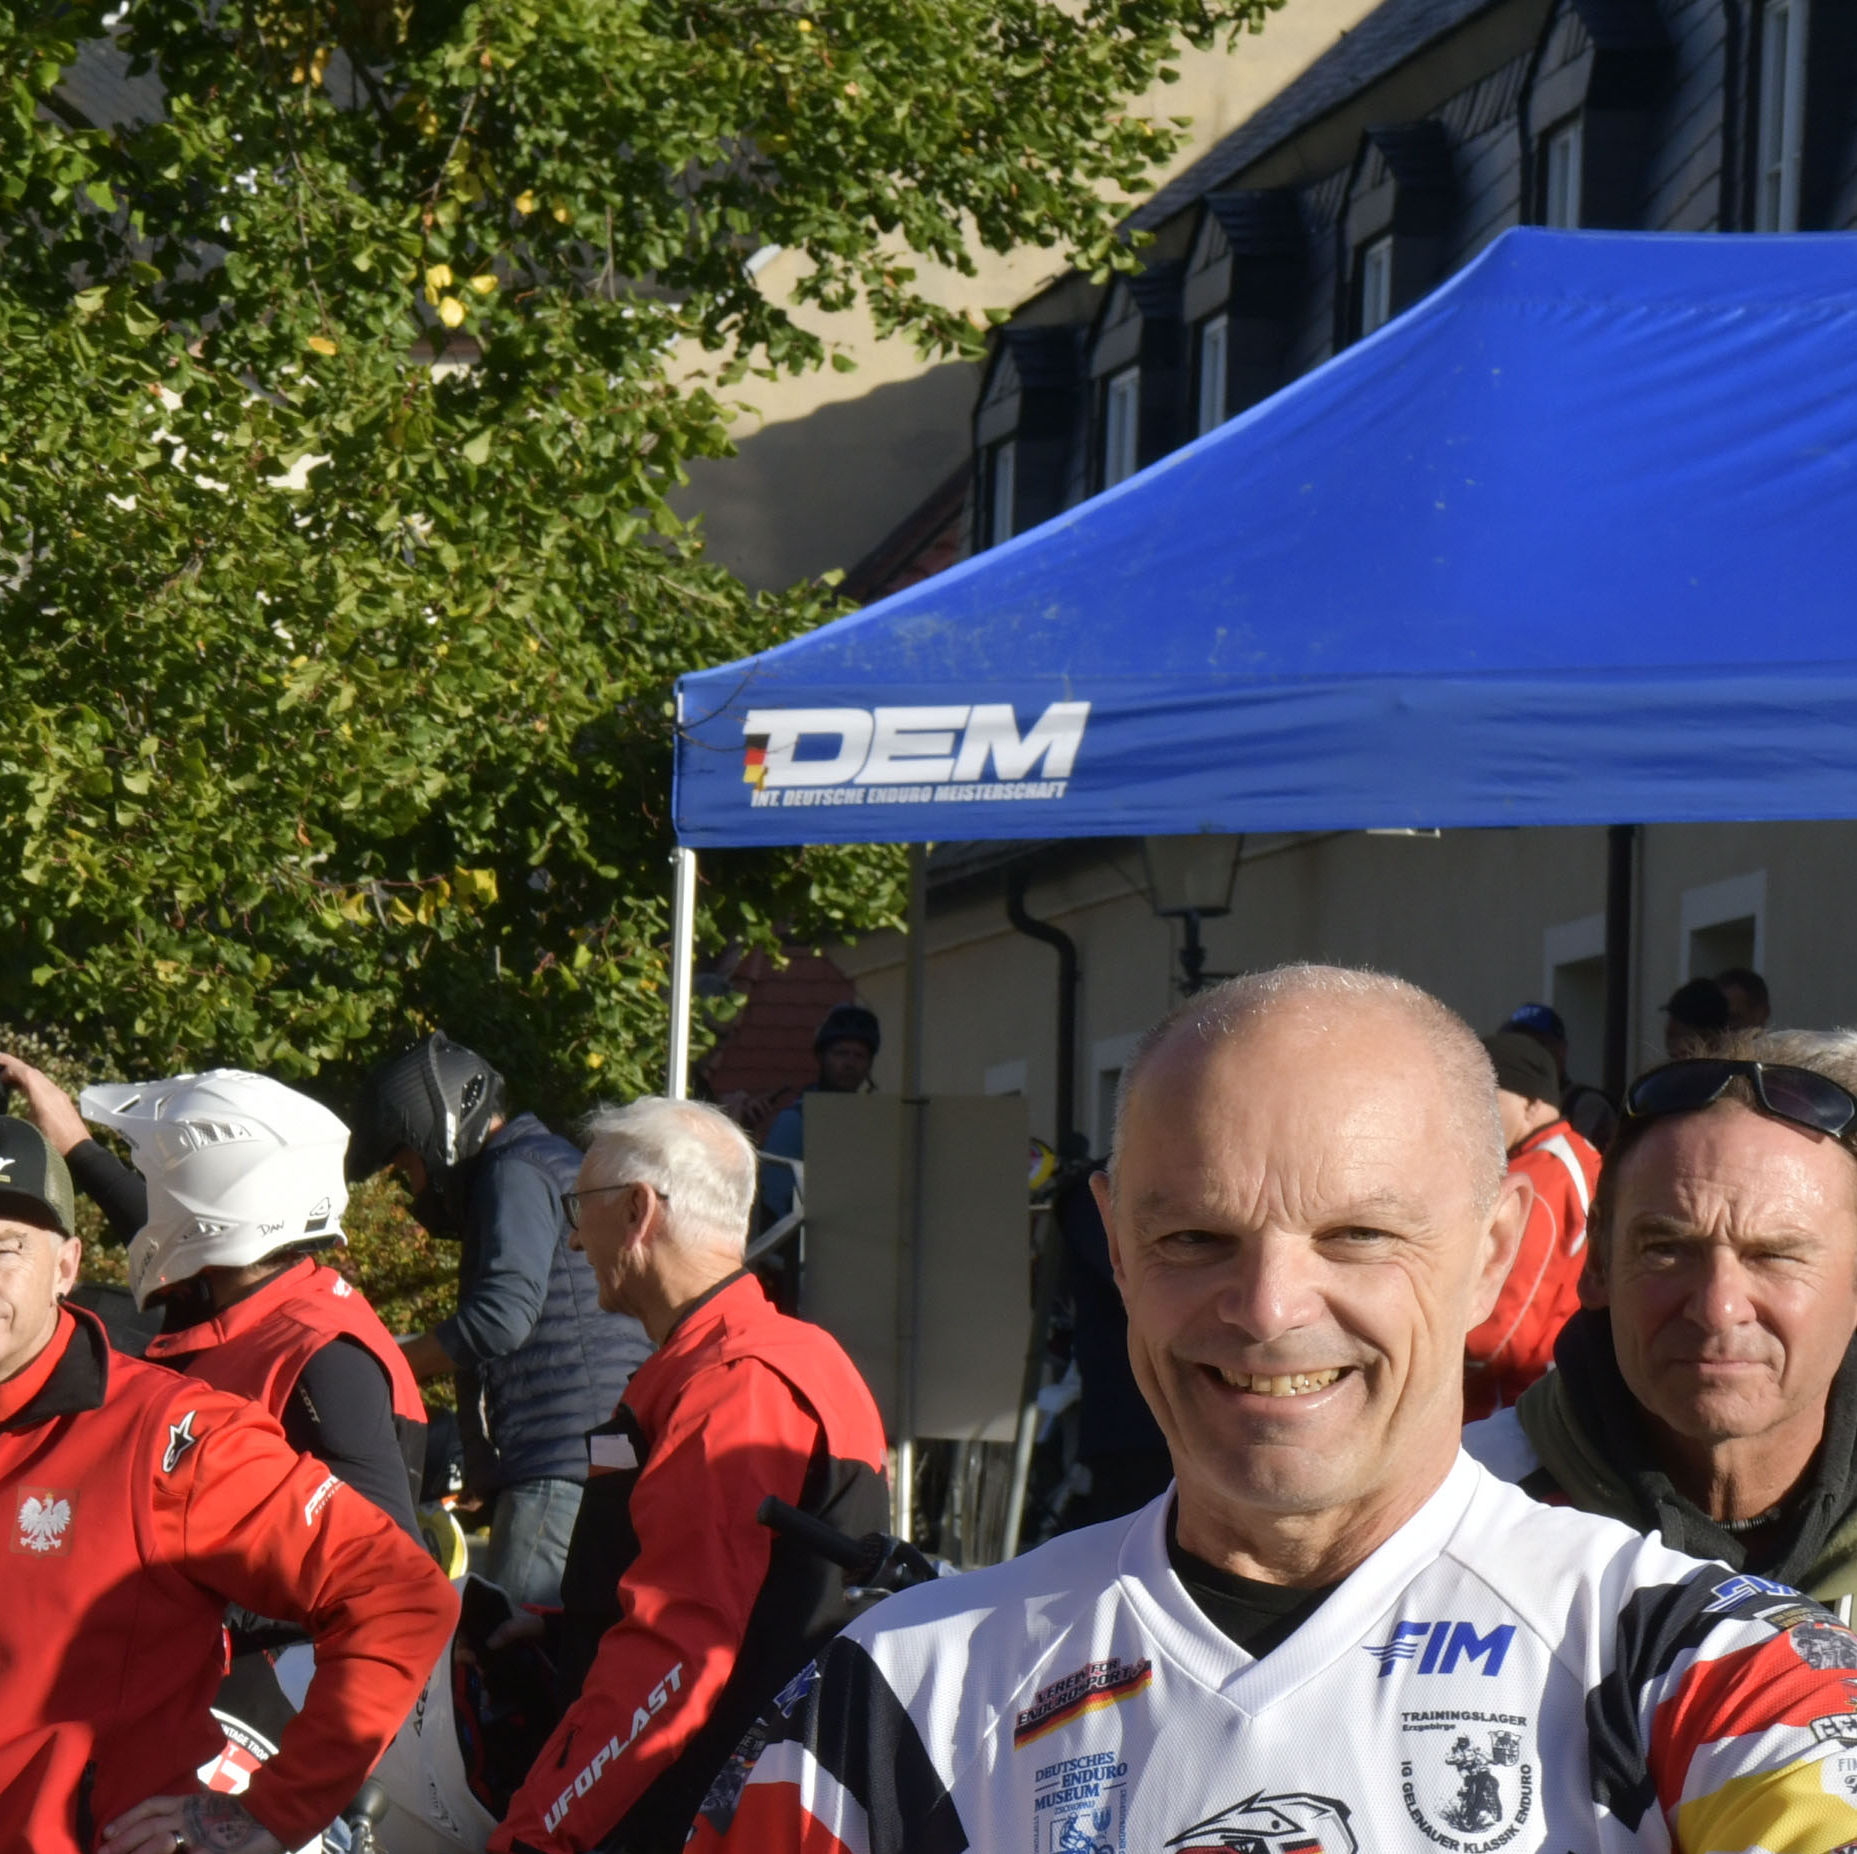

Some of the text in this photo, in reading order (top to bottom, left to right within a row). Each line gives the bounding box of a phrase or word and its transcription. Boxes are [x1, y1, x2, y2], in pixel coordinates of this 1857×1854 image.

[743, 701, 1091, 787] DEM
[783, 787, 864, 807] DEUTSCHE
[867, 785, 931, 804] ENDURO
[934, 781, 1067, 801] MEISTERSCHAFT
[1363, 1620, 1517, 1678] FIM
[1402, 1710, 1528, 1728] TRAININGSLAGER
[542, 1660, 686, 1835] UFOPLAST
[1034, 1751, 1115, 1783] DEUTSCHES
[1061, 1762, 1128, 1788] ENDURO
[1034, 1782, 1101, 1812] MUSEUM
[1515, 1762, 1533, 1825] ENDURO
